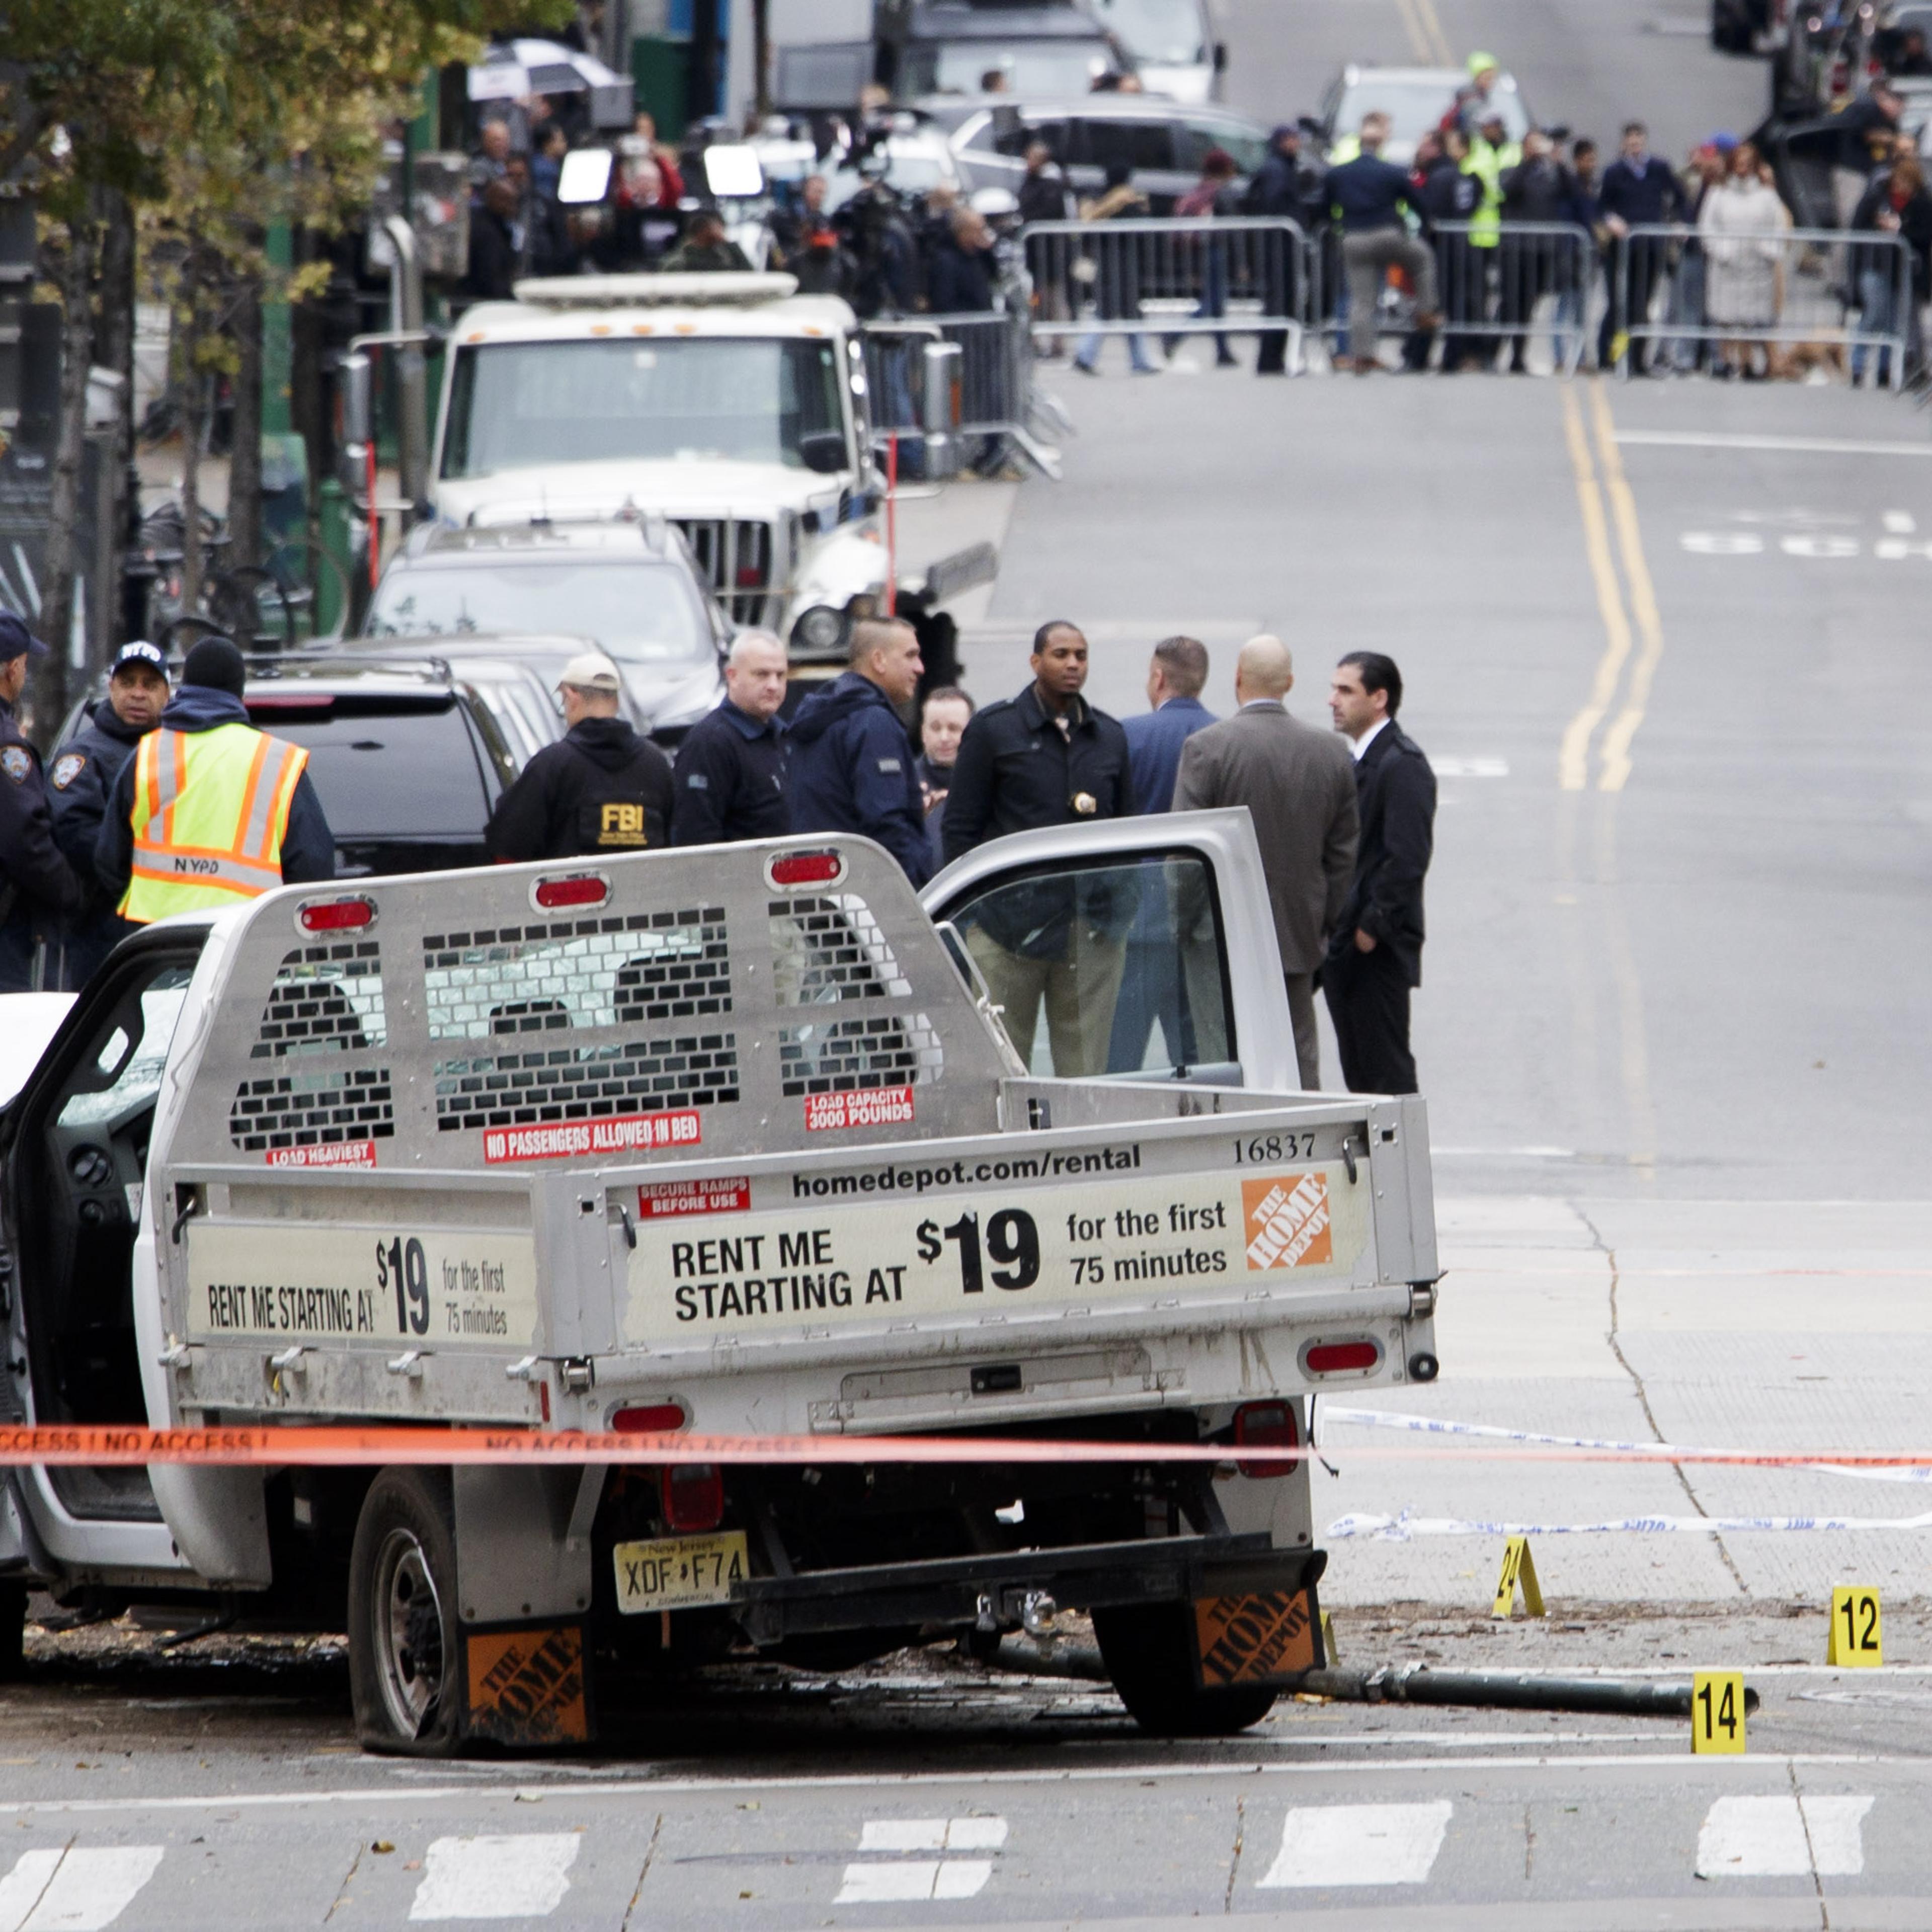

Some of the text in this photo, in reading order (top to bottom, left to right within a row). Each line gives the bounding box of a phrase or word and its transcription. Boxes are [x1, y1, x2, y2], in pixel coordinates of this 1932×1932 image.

[122, 640, 160, 662] NYPD
[602, 803, 643, 832] FBI
[175, 857, 219, 874] NYPD
[809, 1102, 912, 1129] 3000 POUNDS
[811, 1088, 906, 1111] LOAD CAPACITY
[272, 1143, 369, 1167] LOAD HEAVIEST
[487, 1115, 698, 1159] NO PASSENGERS ALLOWED IN BED
[1234, 1133, 1315, 1163] 16837
[641, 1178, 747, 1198] SECURE RAMPS
[792, 1144, 1141, 1198] homedepot.com/rental
[652, 1192, 738, 1214] BEFORE USE
[1067, 1200, 1227, 1242] for the first
[1246, 1172, 1328, 1271] HOME
[1251, 1184, 1287, 1225] THE
[672, 1228, 834, 1278] RENT ME
[916, 1208, 1040, 1294] $19
[1280, 1205, 1330, 1268] DEPOT
[442, 1258, 506, 1294] for the first
[1070, 1247, 1227, 1284] 75 minutes
[376, 1236, 430, 1336] $19
[675, 1265, 907, 1321] STARTING AT
[208, 1284, 373, 1333] RENT ME STARTING AT
[445, 1302, 508, 1335] 75 minutes
[106, 1432, 141, 1451] NO
[1840, 1595, 1878, 1650] 12
[1698, 1681, 1737, 1739] 14
